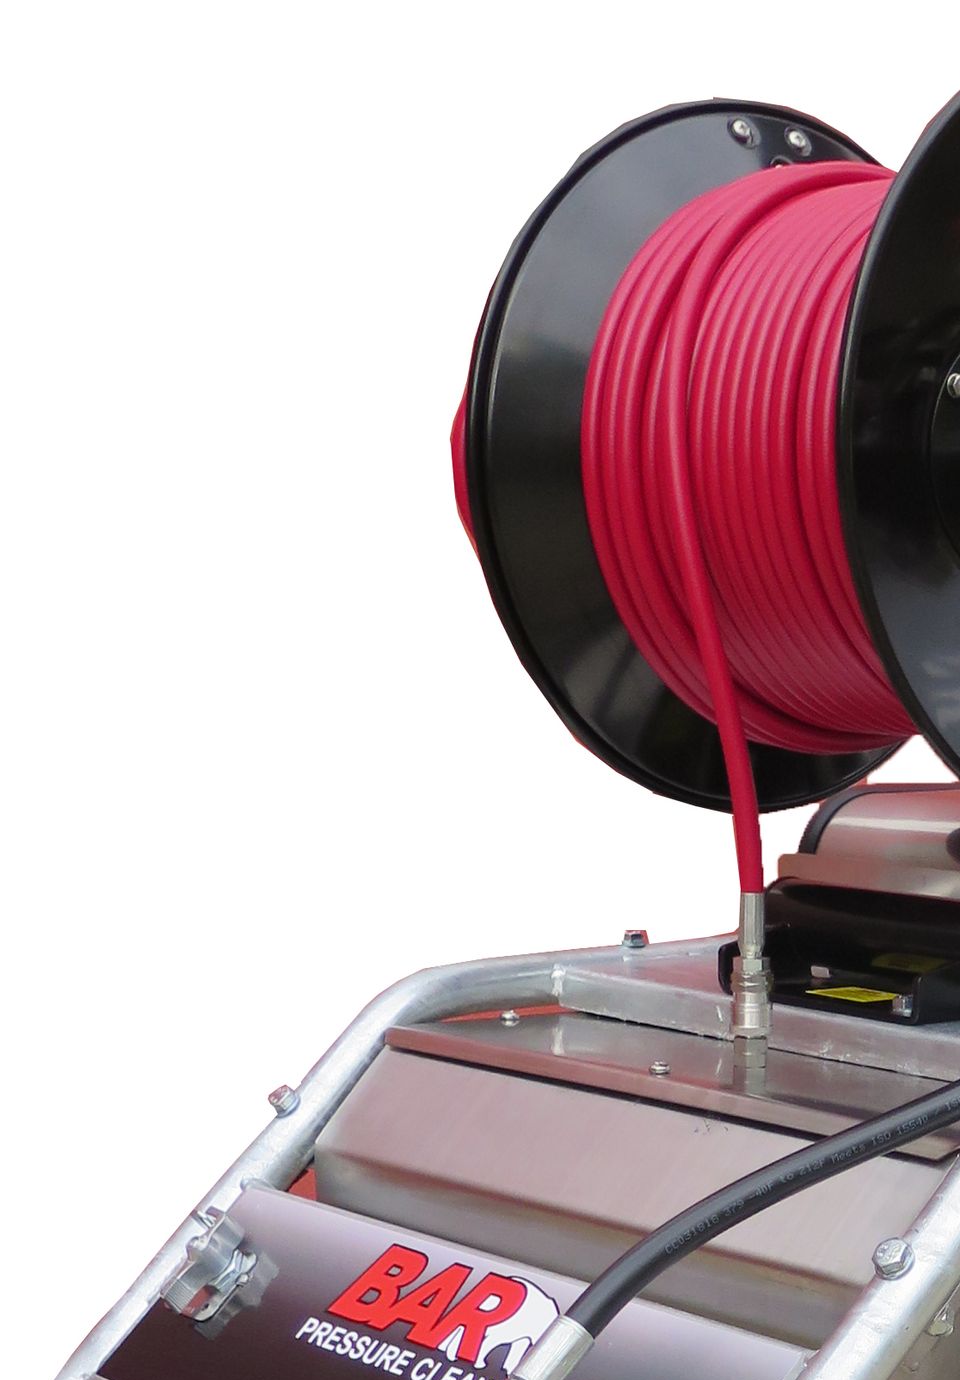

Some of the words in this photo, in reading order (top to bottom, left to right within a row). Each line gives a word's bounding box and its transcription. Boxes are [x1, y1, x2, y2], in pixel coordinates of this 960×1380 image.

[780, 1172, 794, 1184] to
[799, 1159, 825, 1177] 212F
[831, 1144, 866, 1164] Meets
[871, 1132, 892, 1147] ISO
[327, 1243, 527, 1363] BAR
[295, 1316, 416, 1376] PRESSURE
